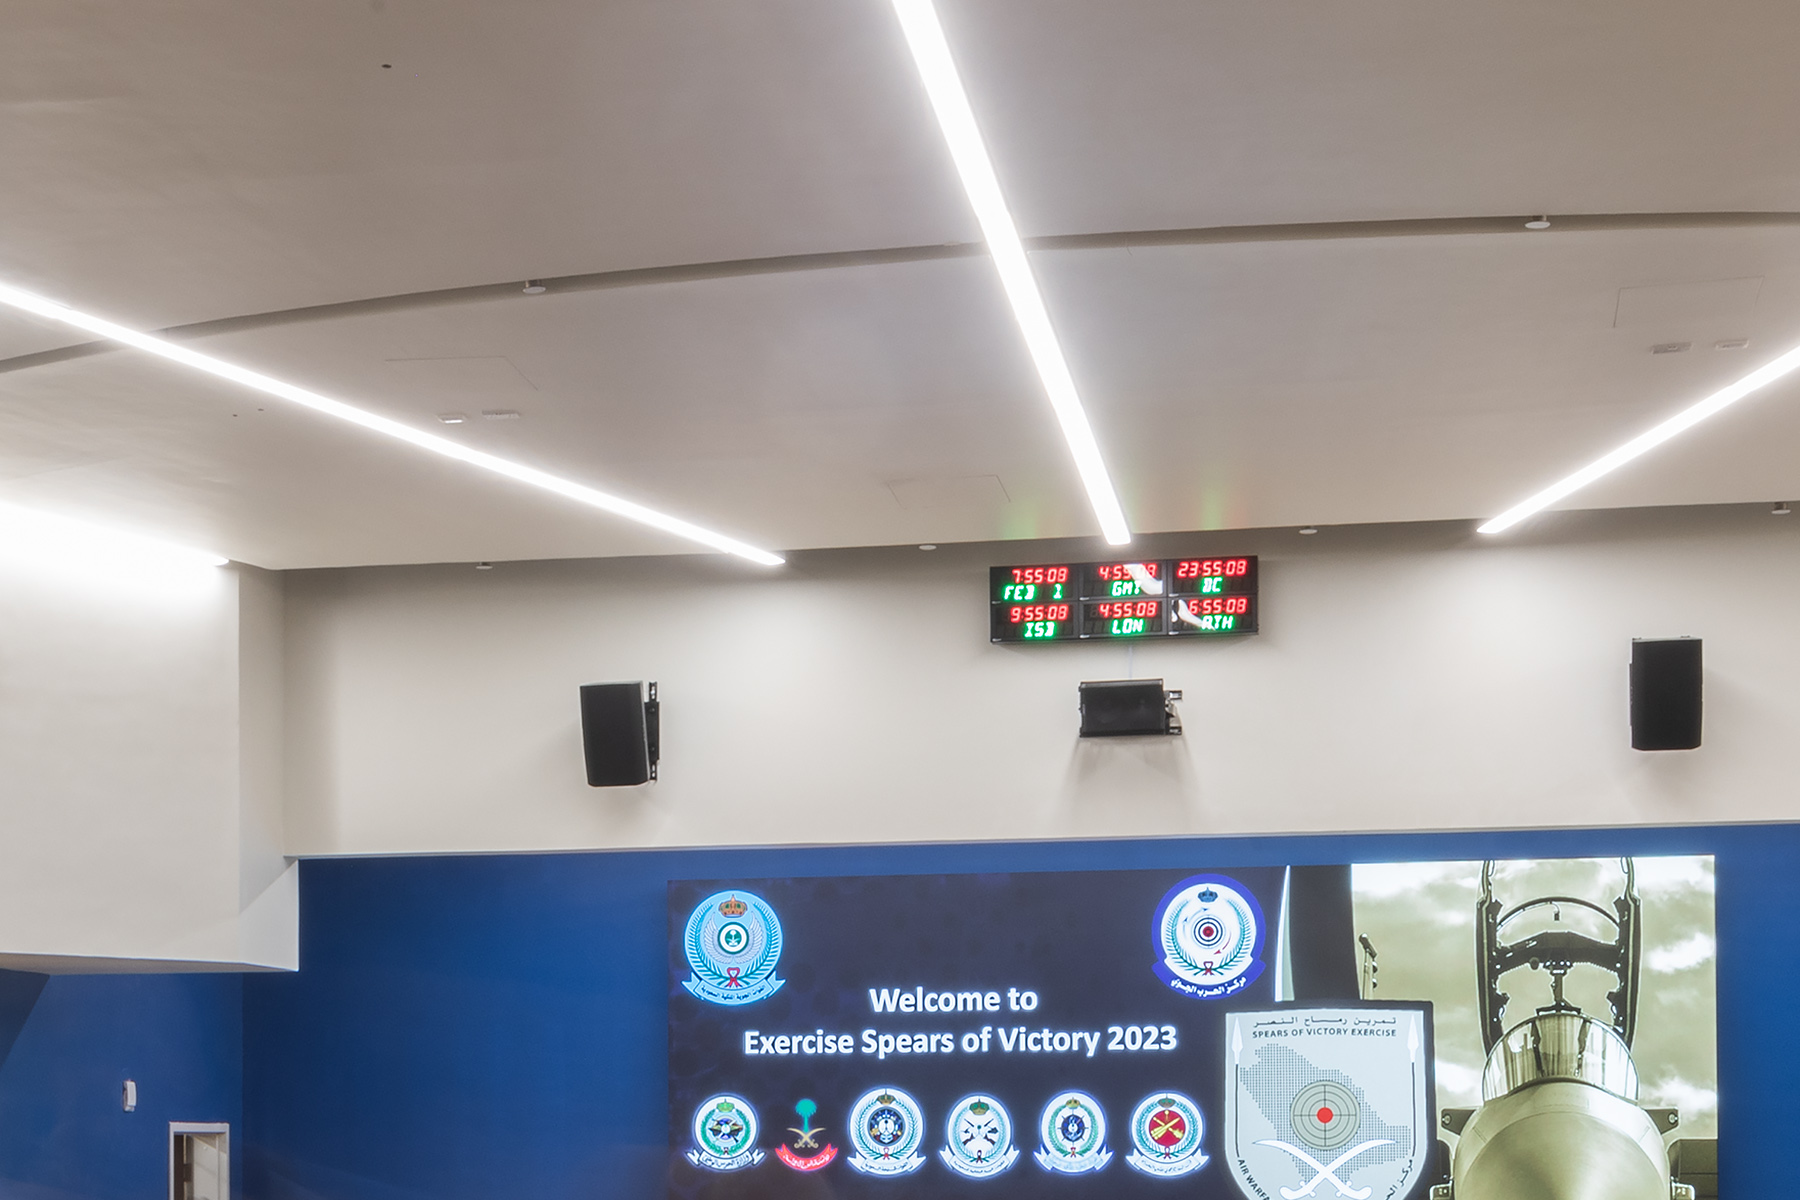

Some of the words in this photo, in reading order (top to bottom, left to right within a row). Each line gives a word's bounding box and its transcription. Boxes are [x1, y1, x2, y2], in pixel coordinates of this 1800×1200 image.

[1012, 567, 1069, 584] 7:55:08
[1177, 559, 1247, 578] 23:55:08
[1111, 580, 1142, 596] GMT
[1202, 577, 1223, 593] DC
[1010, 604, 1069, 623] 9:55:08
[1098, 601, 1157, 618] 4:55:08
[1188, 597, 1247, 615] 6:55:08
[1112, 618, 1144, 634] LON
[869, 987, 1001, 1013] Welcome
[1008, 988, 1038, 1012] to
[1252, 1029, 1289, 1039] SPEARS
[1291, 1028, 1304, 1037] OF
[1306, 1027, 1349, 1036] VICTORY
[1351, 1028, 1397, 1037] EXERCISE
[744, 1029, 855, 1054] Exercise
[861, 1028, 955, 1059] Spears
[962, 1026, 992, 1053] of
[997, 1027, 1101, 1058] Victory
[1107, 1025, 1178, 1051] 2023
[1237, 1159, 1249, 1176] AIR
